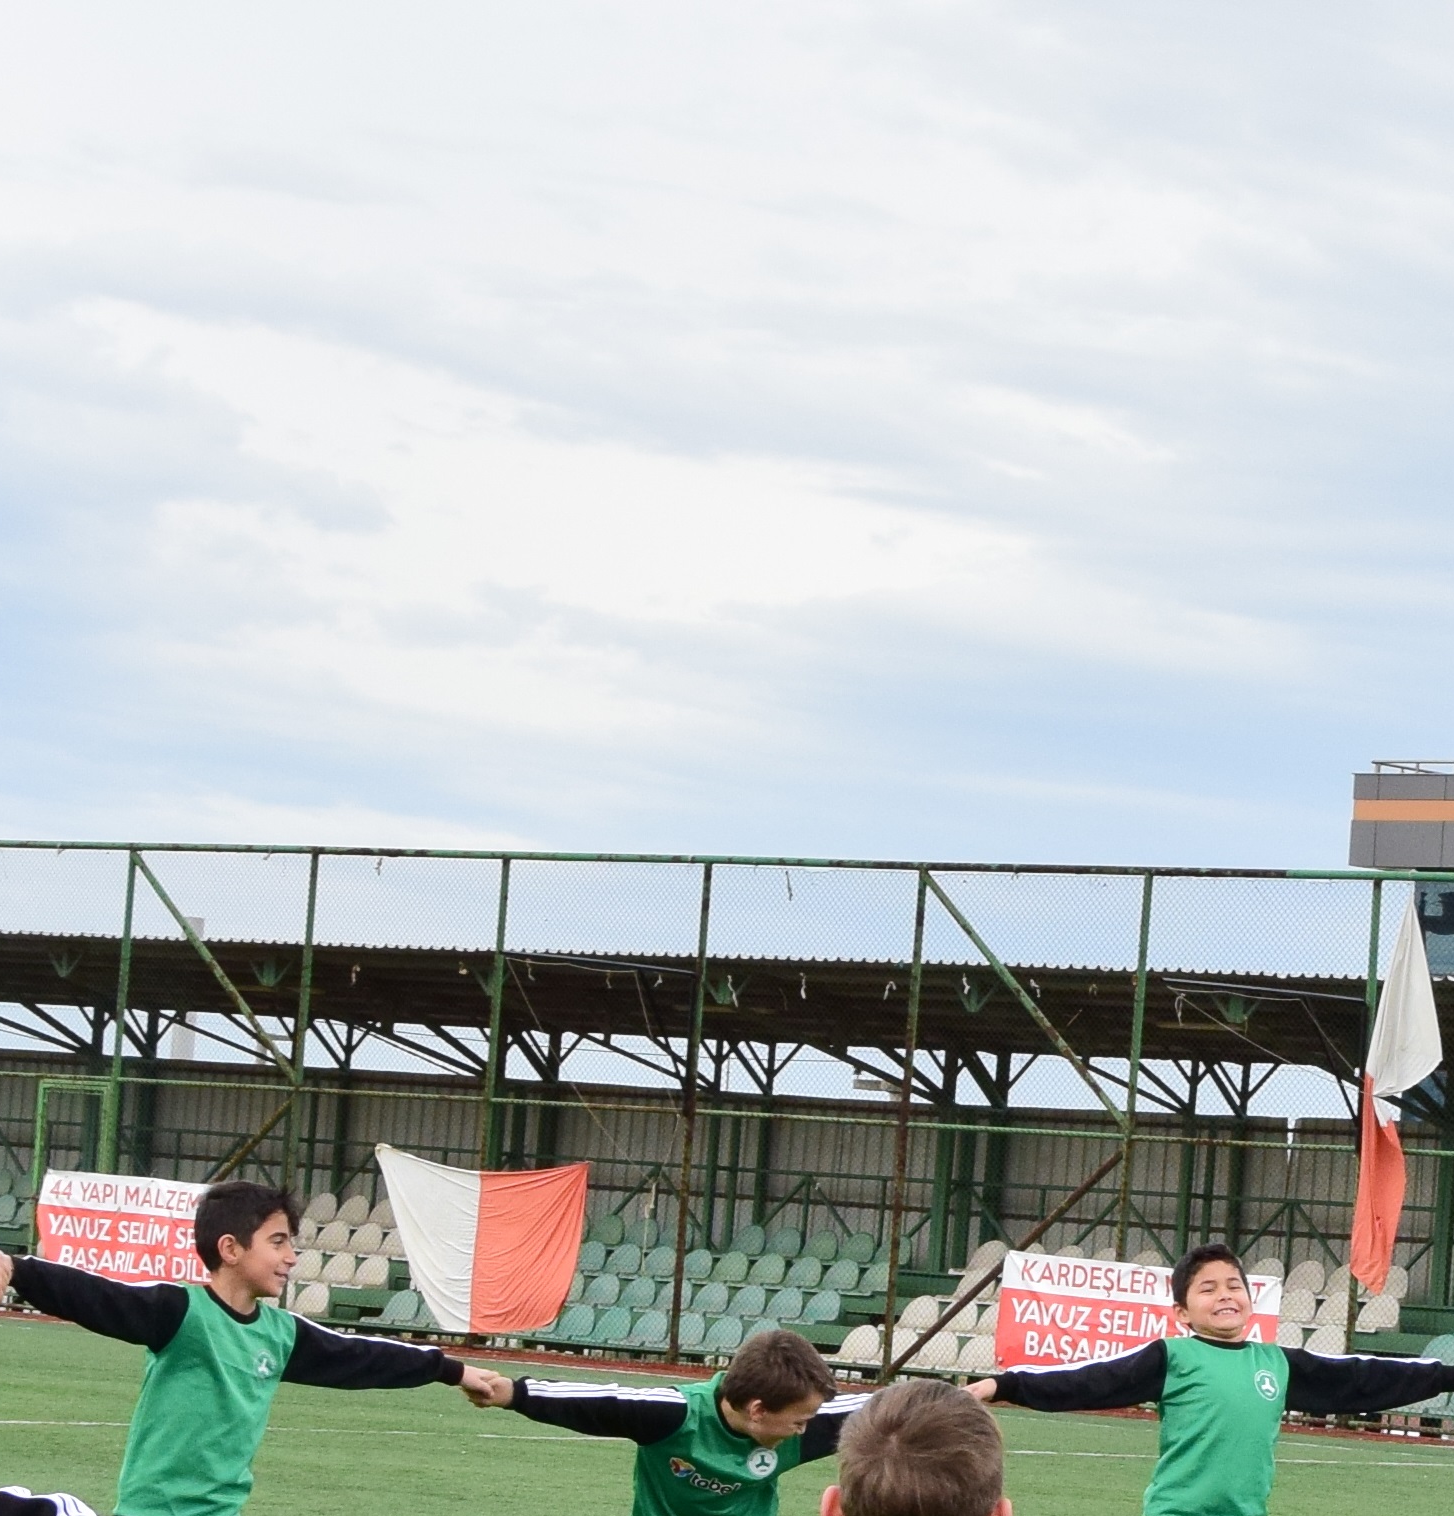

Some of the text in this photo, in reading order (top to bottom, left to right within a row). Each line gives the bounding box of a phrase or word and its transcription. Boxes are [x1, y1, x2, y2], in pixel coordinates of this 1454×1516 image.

[50, 1180, 72, 1200] 44
[80, 1181, 118, 1204] YAPI
[48, 1213, 112, 1241] YAVUZ
[117, 1217, 169, 1247] SELİM
[58, 1245, 166, 1277] BAŞARILAR
[1021, 1259, 1157, 1298] KARDEŞLER
[1011, 1297, 1091, 1332] YAVUZ
[1097, 1306, 1168, 1337] SELİM
